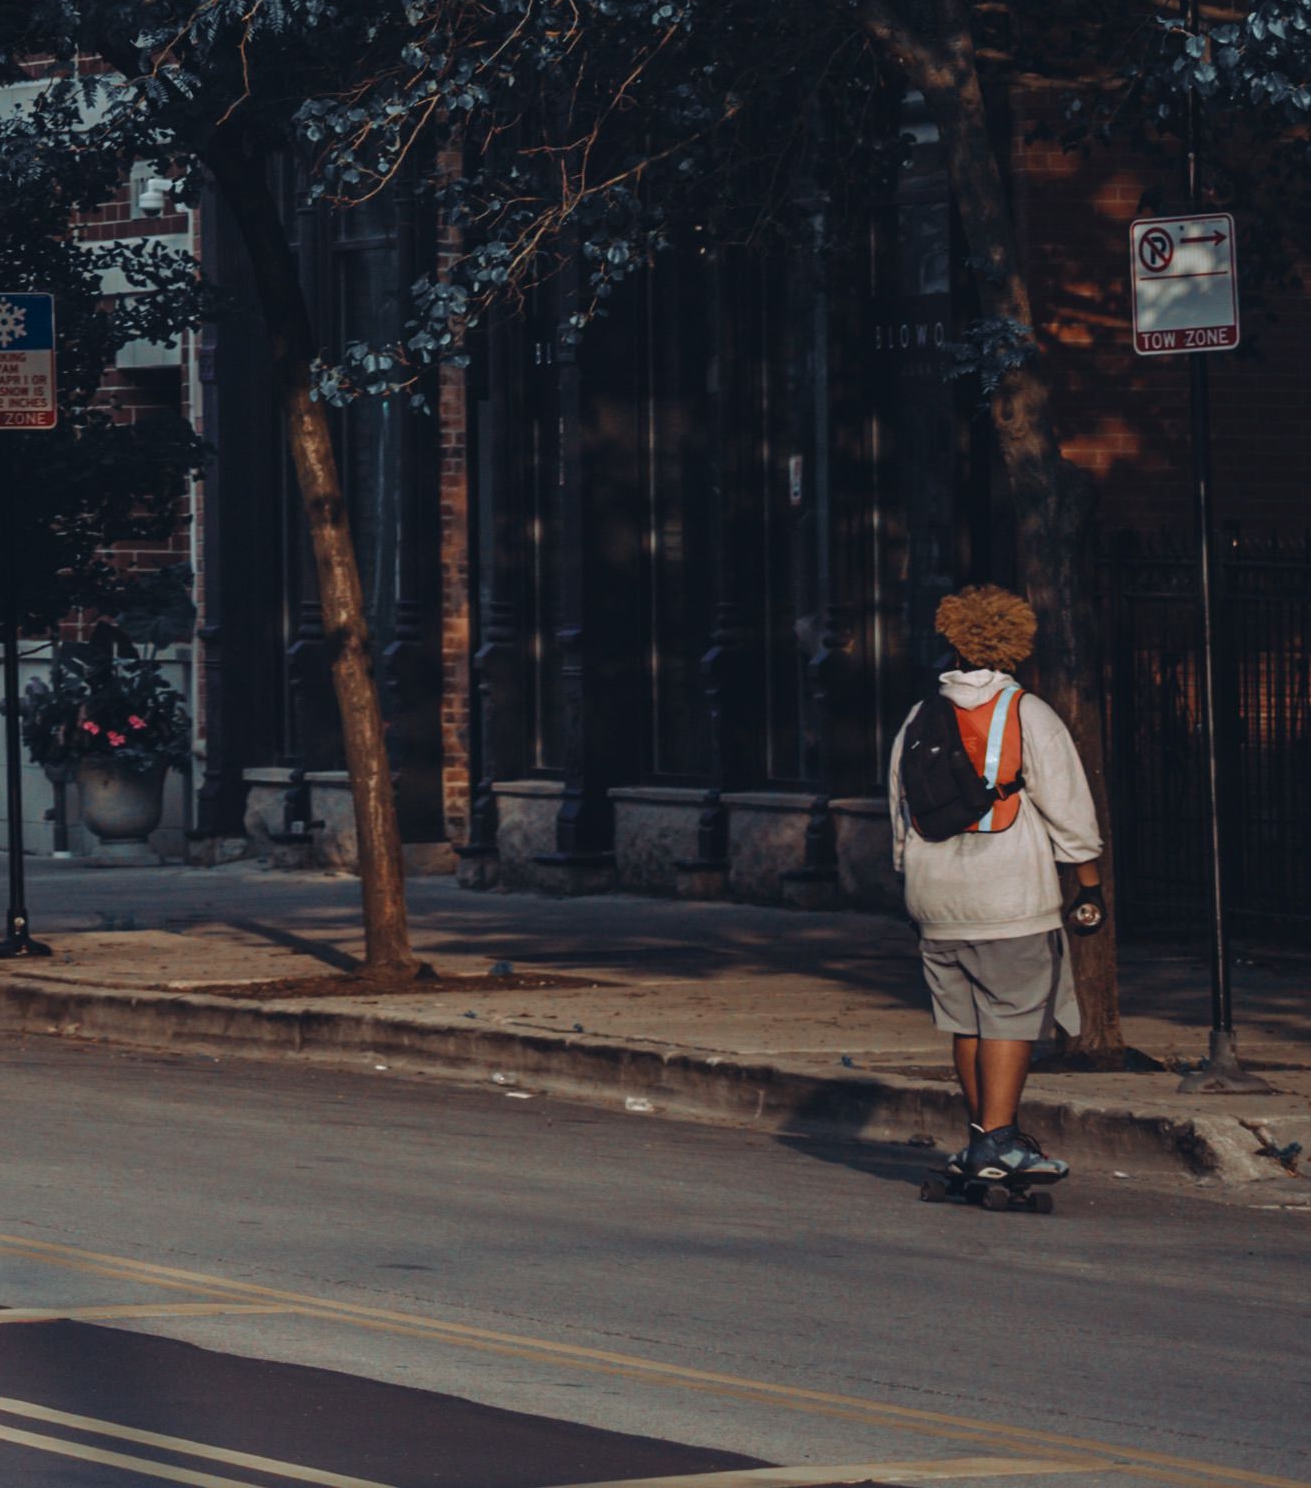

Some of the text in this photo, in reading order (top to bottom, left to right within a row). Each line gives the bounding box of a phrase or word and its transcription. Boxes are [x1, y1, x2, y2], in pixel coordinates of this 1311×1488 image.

[1141, 327, 1229, 349] TOW ZONE
[32, 375, 47, 385] OR
[33, 387, 44, 397] IS
[8, 398, 48, 408] INCHES
[5, 413, 47, 425] ZONE
